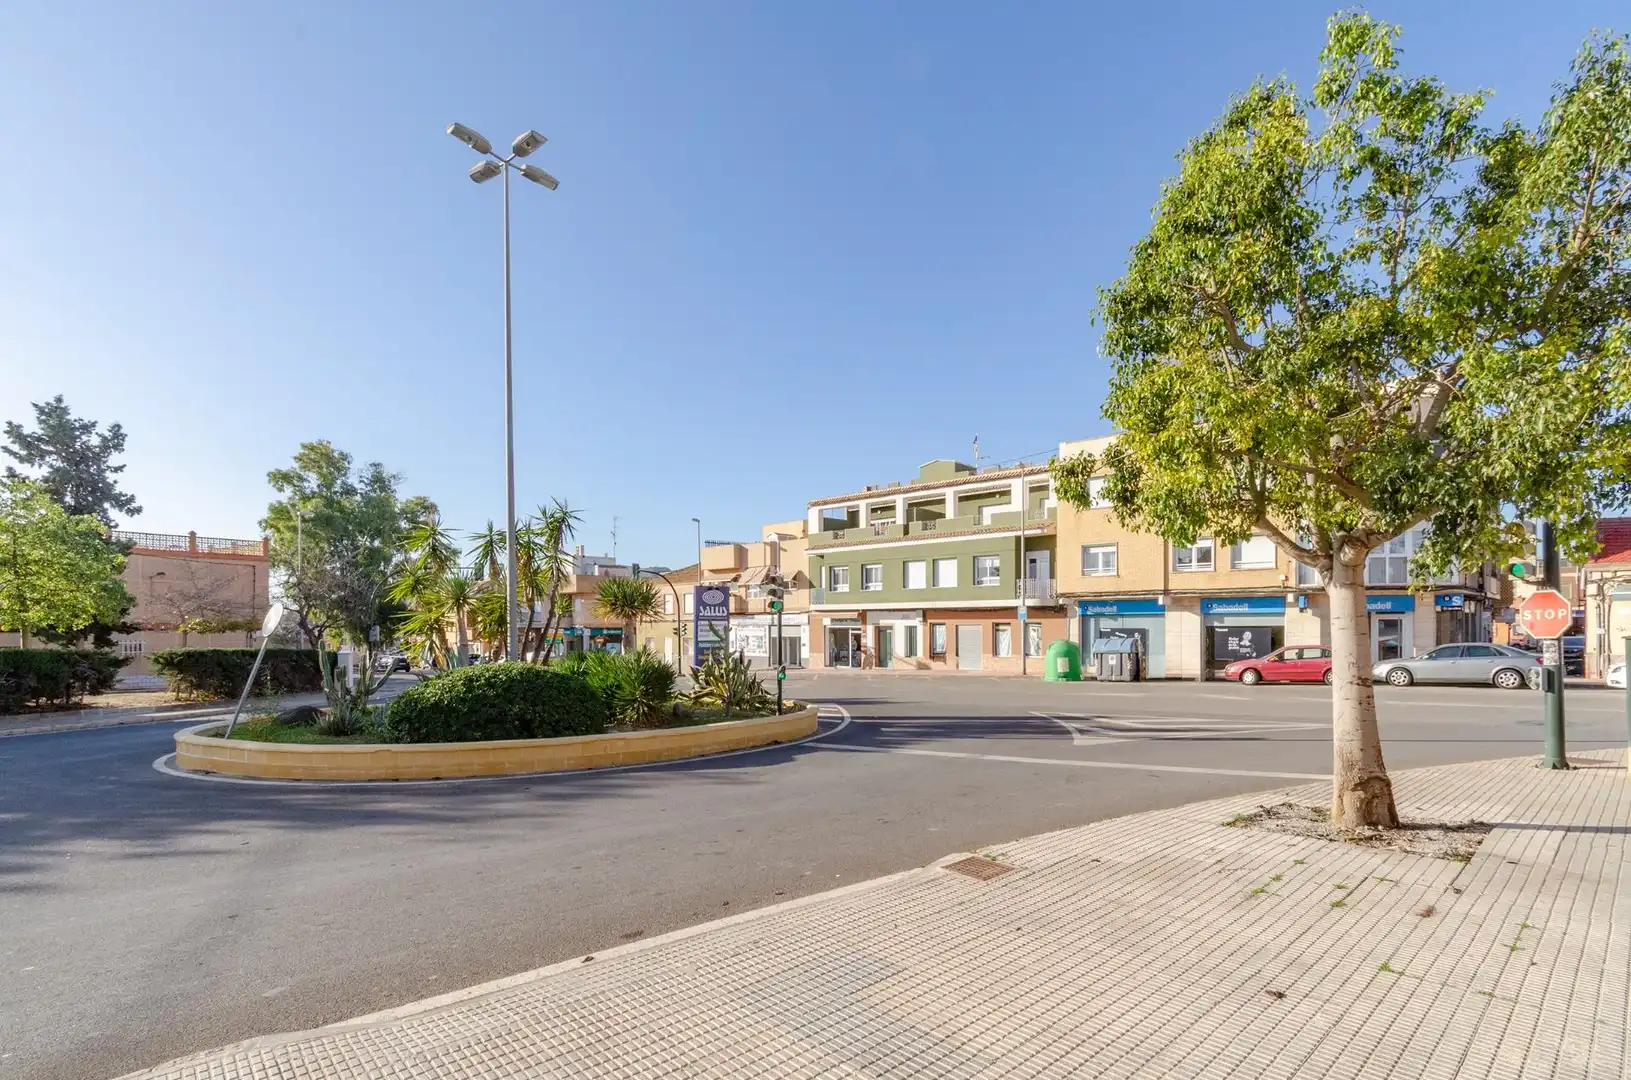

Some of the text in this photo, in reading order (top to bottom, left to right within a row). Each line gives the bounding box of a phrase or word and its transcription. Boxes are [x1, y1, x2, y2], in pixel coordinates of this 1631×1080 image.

[699, 606, 728, 616] SALUS
[1087, 604, 1118, 613] Sabadell
[1212, 602, 1249, 611] Sabadell
[1523, 608, 1567, 620] STOP
